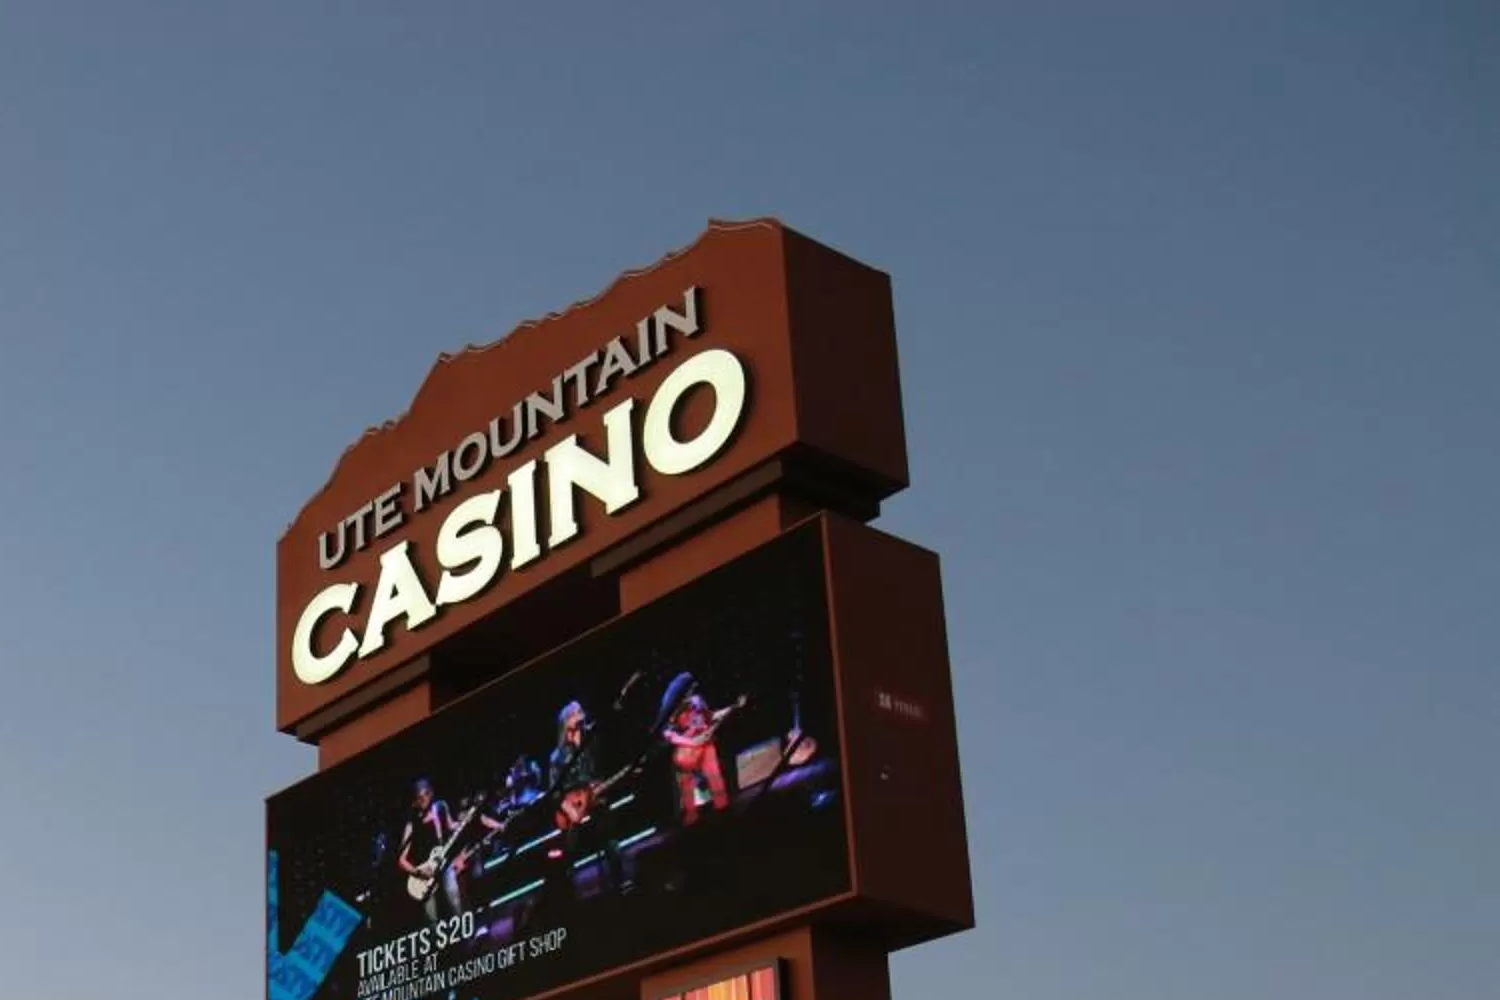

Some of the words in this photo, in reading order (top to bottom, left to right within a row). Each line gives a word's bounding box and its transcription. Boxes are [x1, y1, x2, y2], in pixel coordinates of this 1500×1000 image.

[317, 484, 404, 569] UTE
[412, 286, 702, 511] MOUNTAIN
[291, 348, 746, 684] CASINO
[356, 928, 431, 977] TICKETS
[436, 911, 474, 948] $20
[357, 961, 418, 998] AVAILABLE
[423, 952, 439, 974] AT
[449, 953, 495, 985] CASINO
[497, 942, 526, 969] GIFT
[529, 927, 568, 957] SHOP
